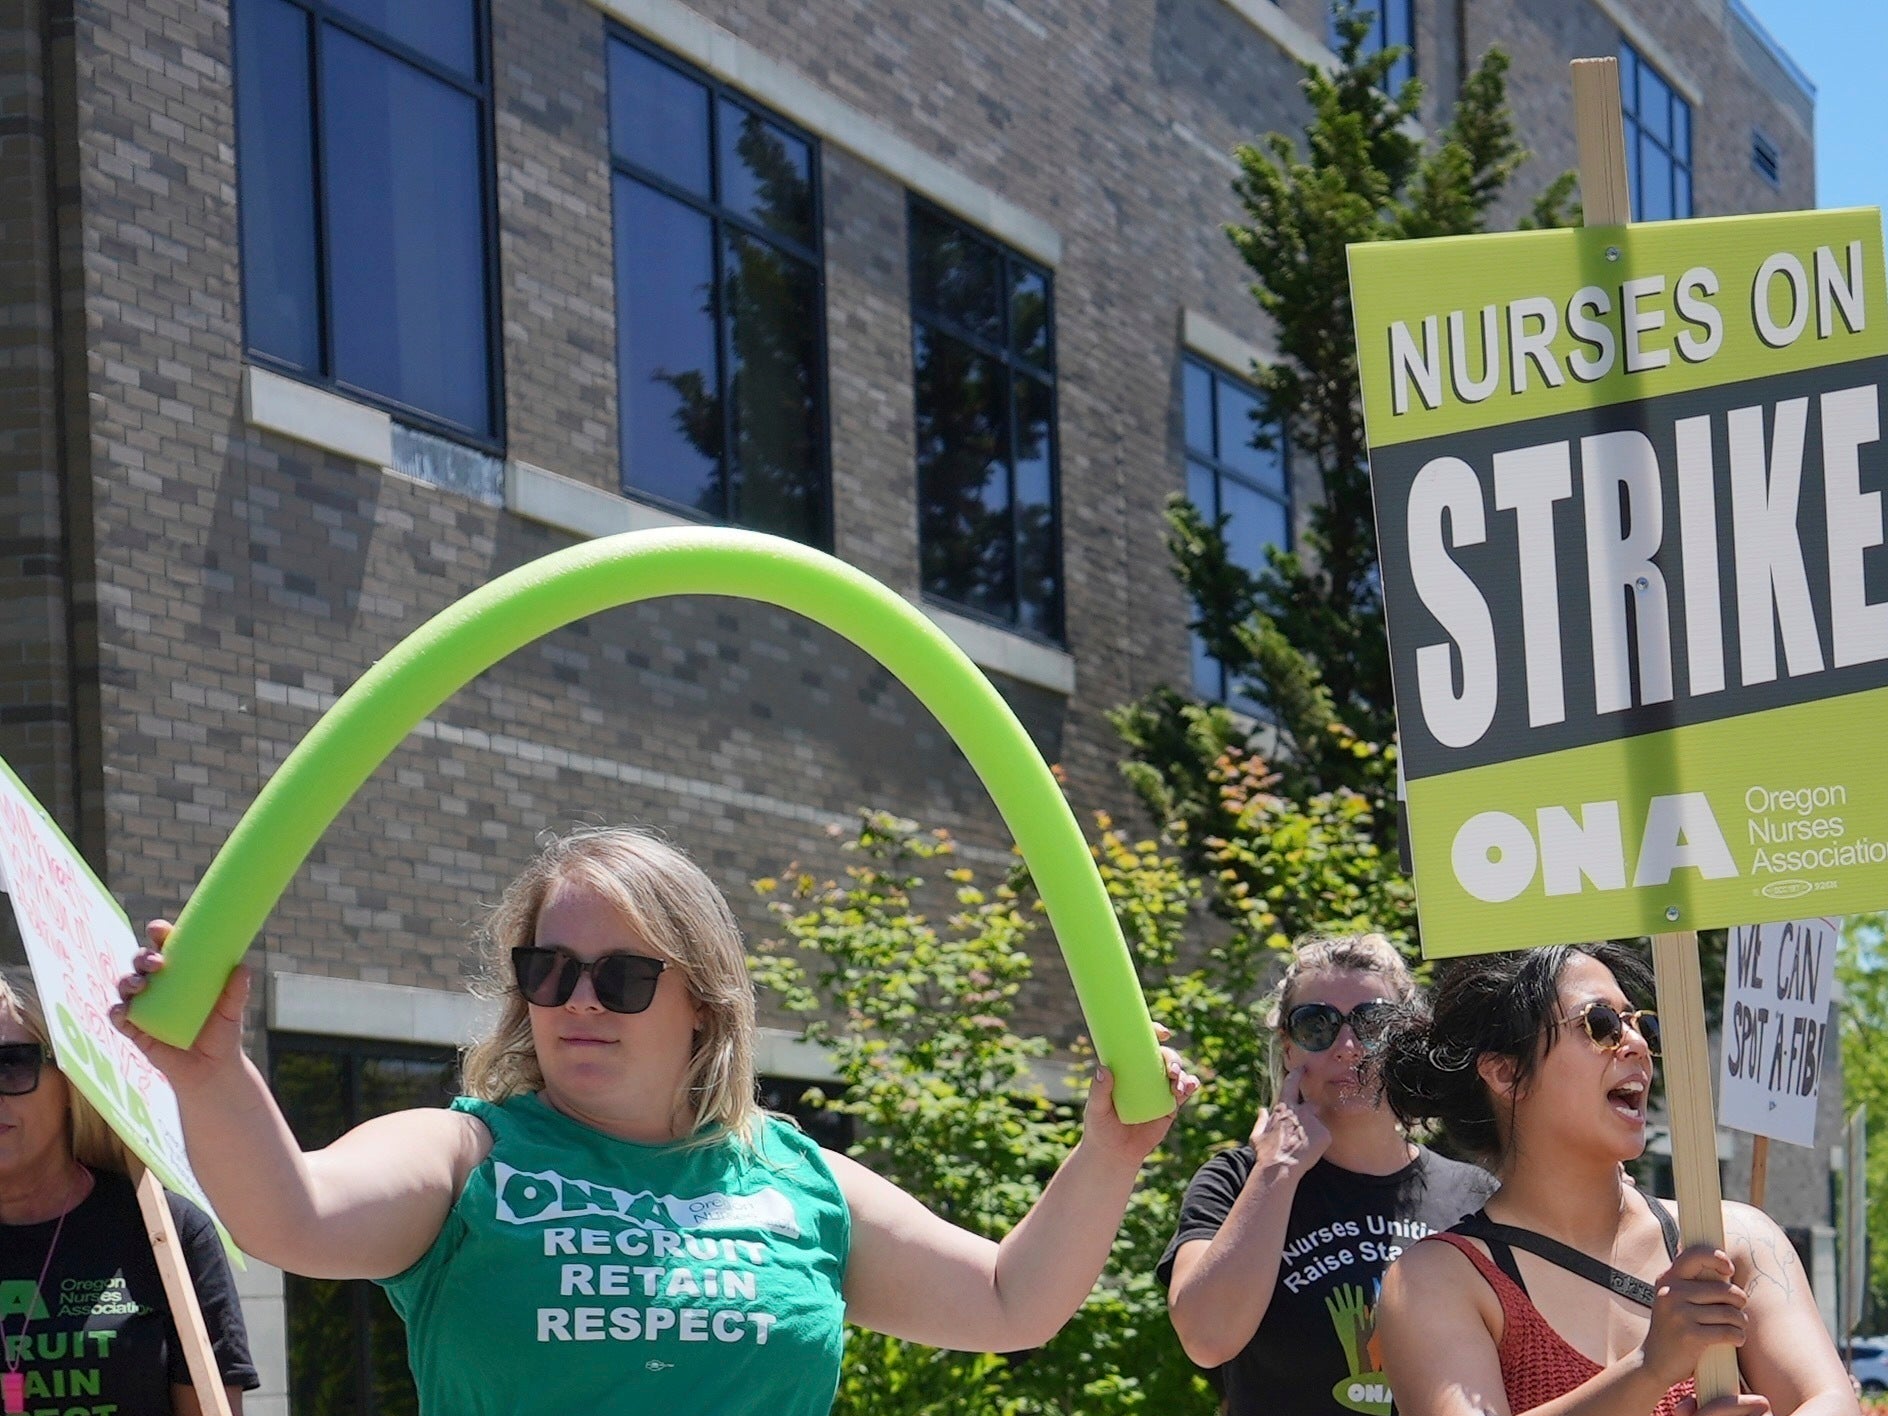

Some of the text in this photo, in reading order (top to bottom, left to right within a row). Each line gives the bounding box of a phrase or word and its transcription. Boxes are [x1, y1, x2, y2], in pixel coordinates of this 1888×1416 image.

[1388, 241, 1867, 417] NURSES ON
[1745, 785, 1846, 815] Oregon
[1451, 791, 1739, 903] ONA
[1748, 816, 1844, 845] Nurses
[1738, 922, 1823, 1004] WE CAN
[1728, 1000, 1769, 1084] SPOT
[53, 1000, 165, 1155] ONA
[501, 1172, 683, 1230] ONA
[543, 1227, 767, 1265] RECRUIT
[1281, 1218, 1360, 1266] Nurses
[60, 1277, 126, 1292] Oregon
[560, 1263, 757, 1300] RETAIN
[1283, 1247, 1355, 1294] Raise
[57, 1301, 153, 1317] Association
[59, 1290, 122, 1304] Nurses
[536, 1306, 777, 1345] RESPECT
[6, 1330, 117, 1361] RUIT
